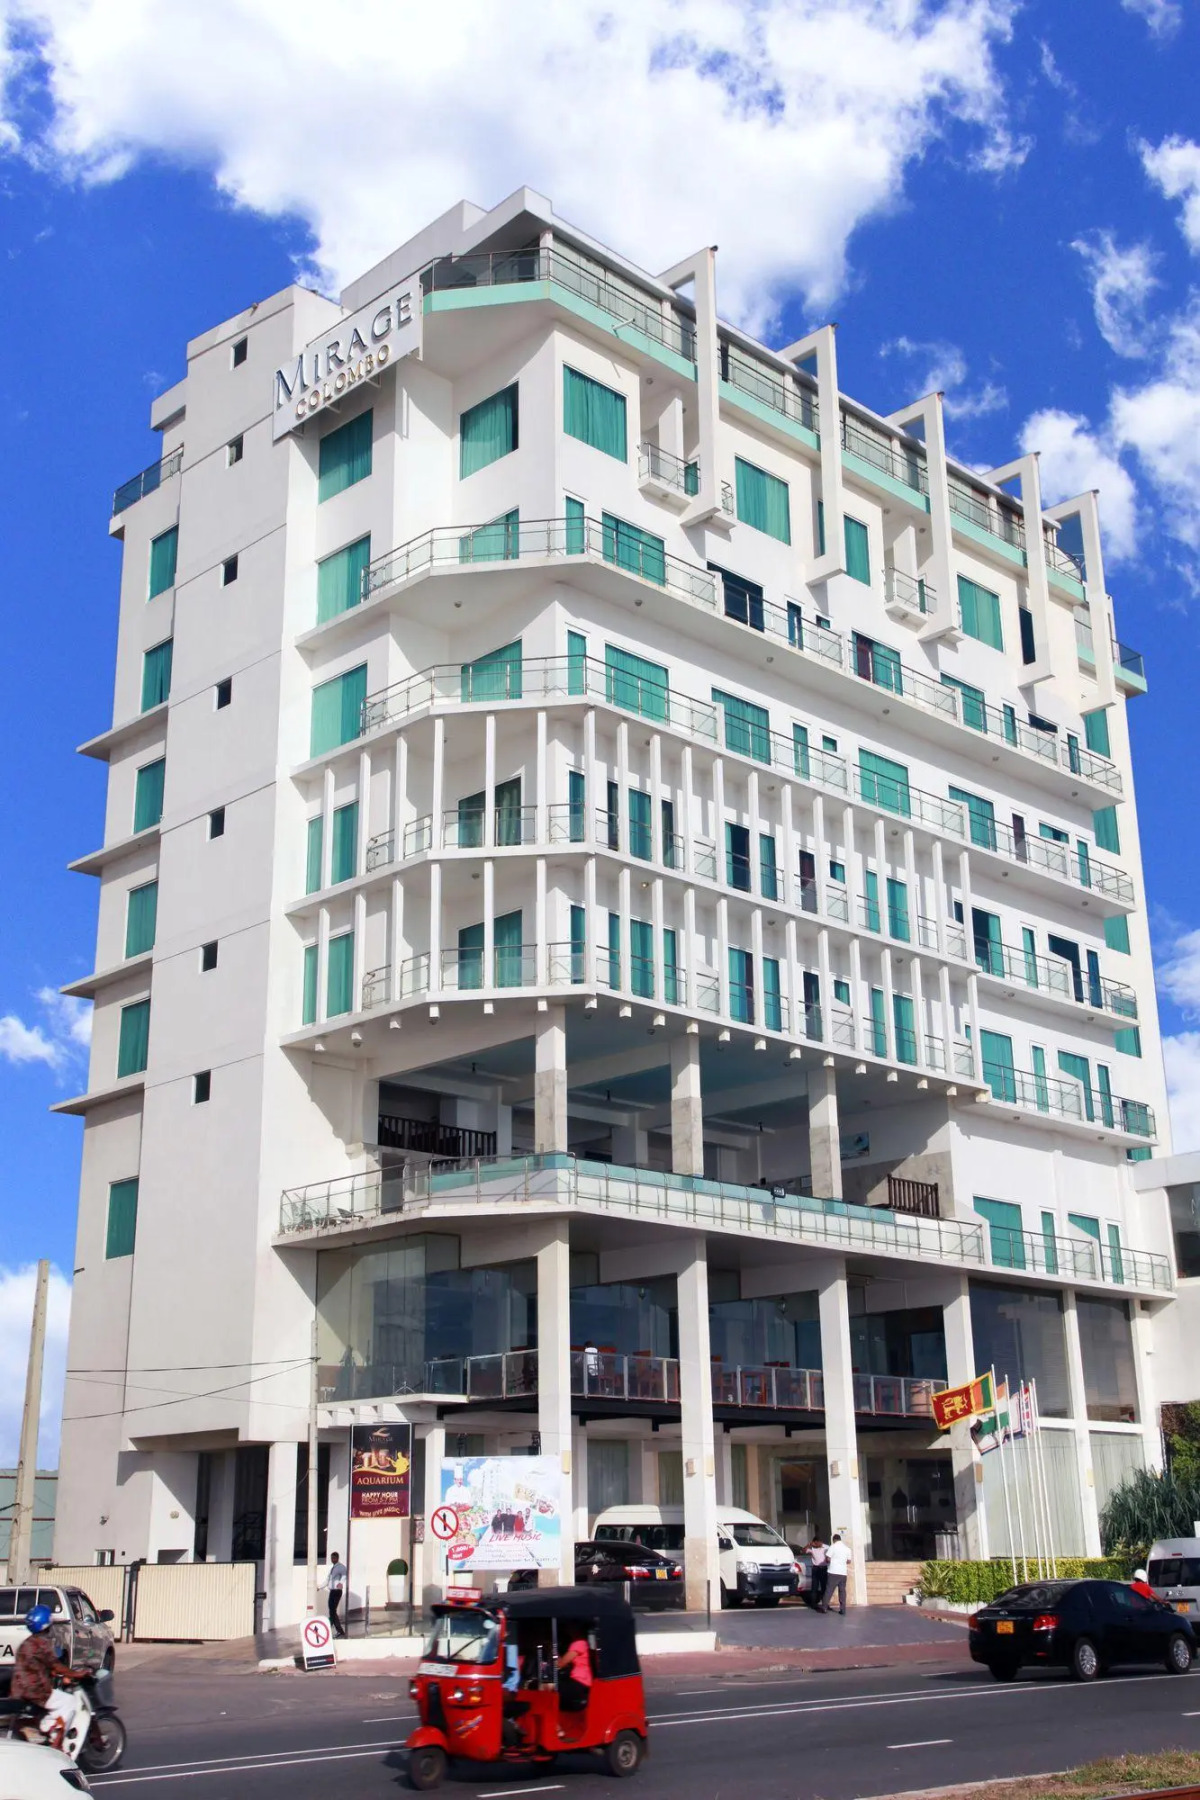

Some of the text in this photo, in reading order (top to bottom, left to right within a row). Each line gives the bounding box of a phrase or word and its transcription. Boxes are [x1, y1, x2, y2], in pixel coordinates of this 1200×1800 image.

[276, 292, 413, 408] MIRAGE
[296, 345, 390, 417] COLOMBO
[357, 1476, 404, 1485] AQUARIUM
[384, 1506, 401, 1515] MUSIC
[489, 1532, 542, 1542] LIVE MUSIC
